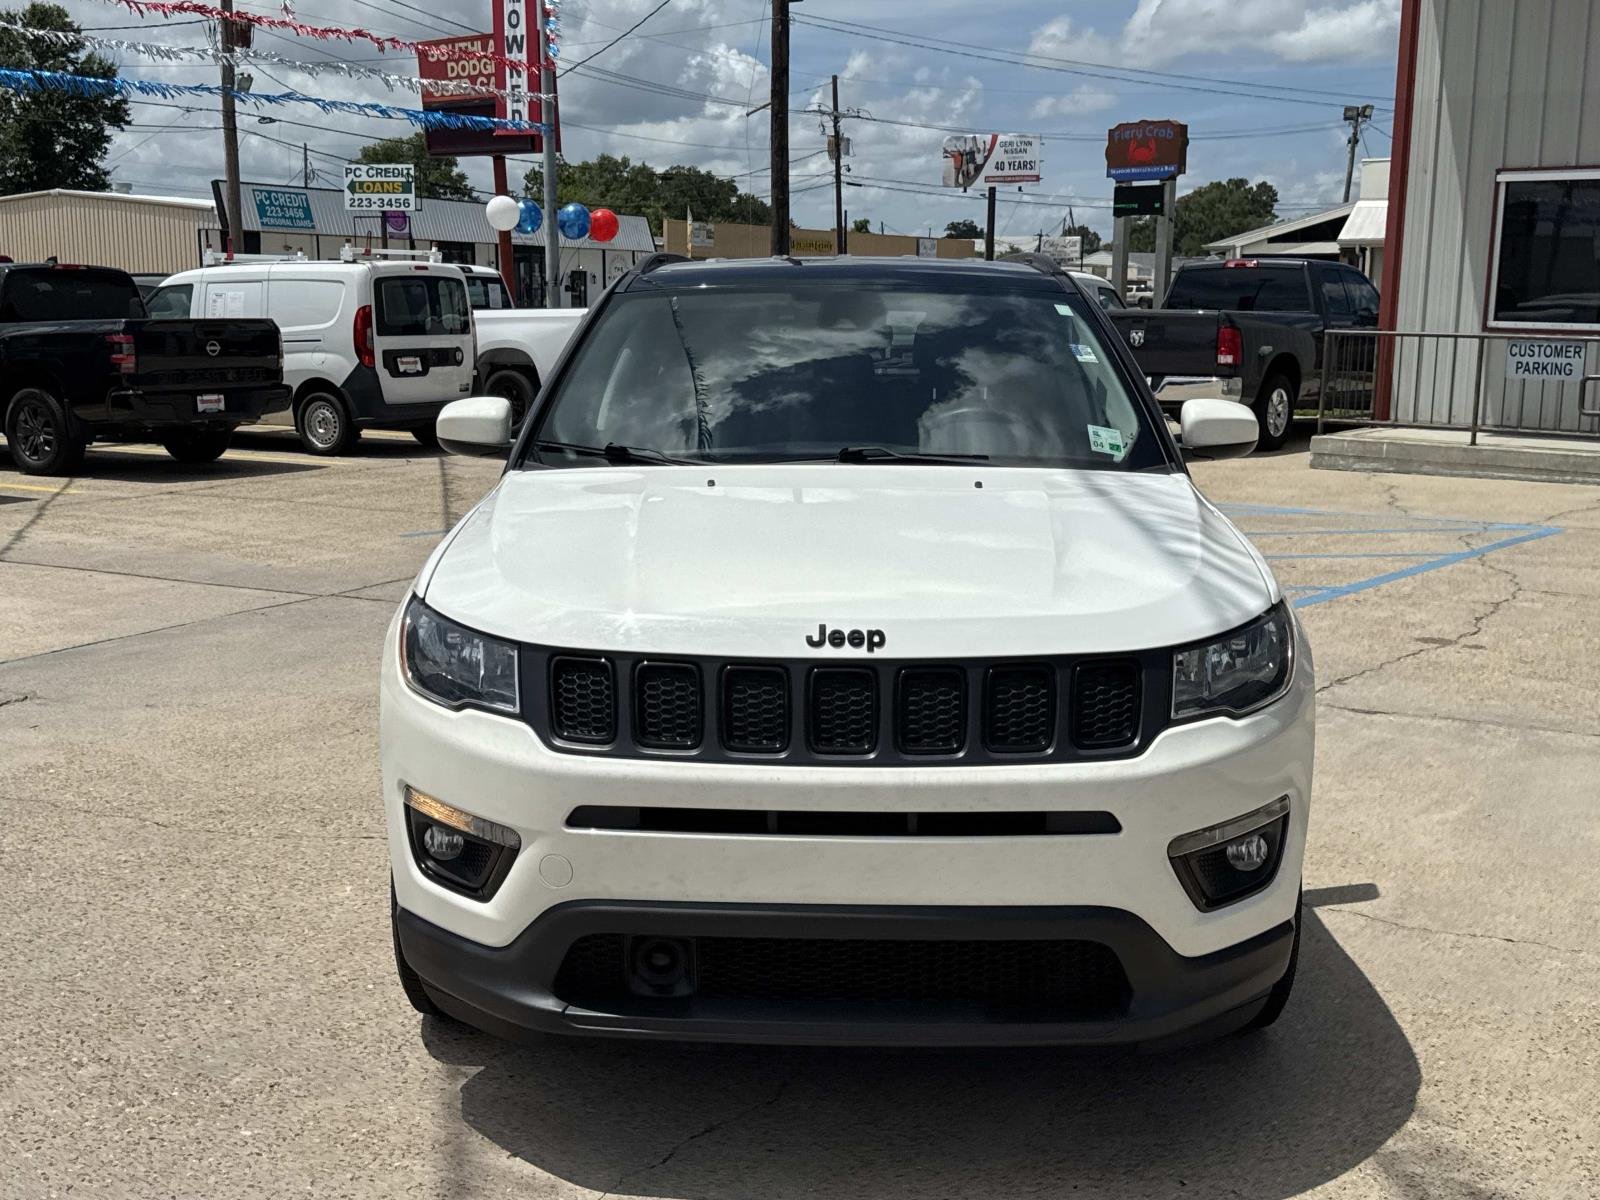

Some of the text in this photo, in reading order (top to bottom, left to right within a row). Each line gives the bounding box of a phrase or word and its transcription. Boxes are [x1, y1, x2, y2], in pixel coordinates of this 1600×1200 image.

[1145, 125, 1174, 139] Crab
[994, 160, 1036, 171] 40 YEARS!
[345, 167, 412, 178] PC CREDIT
[355, 182, 402, 193] LOANS
[254, 191, 308, 207] PC CREDIT
[349, 198, 411, 208] 223-3456
[265, 206, 305, 218] 223-3456
[1509, 343, 1582, 359] CUSTOMER
[1515, 361, 1573, 376] PARKING
[805, 623, 886, 653] Jeep
